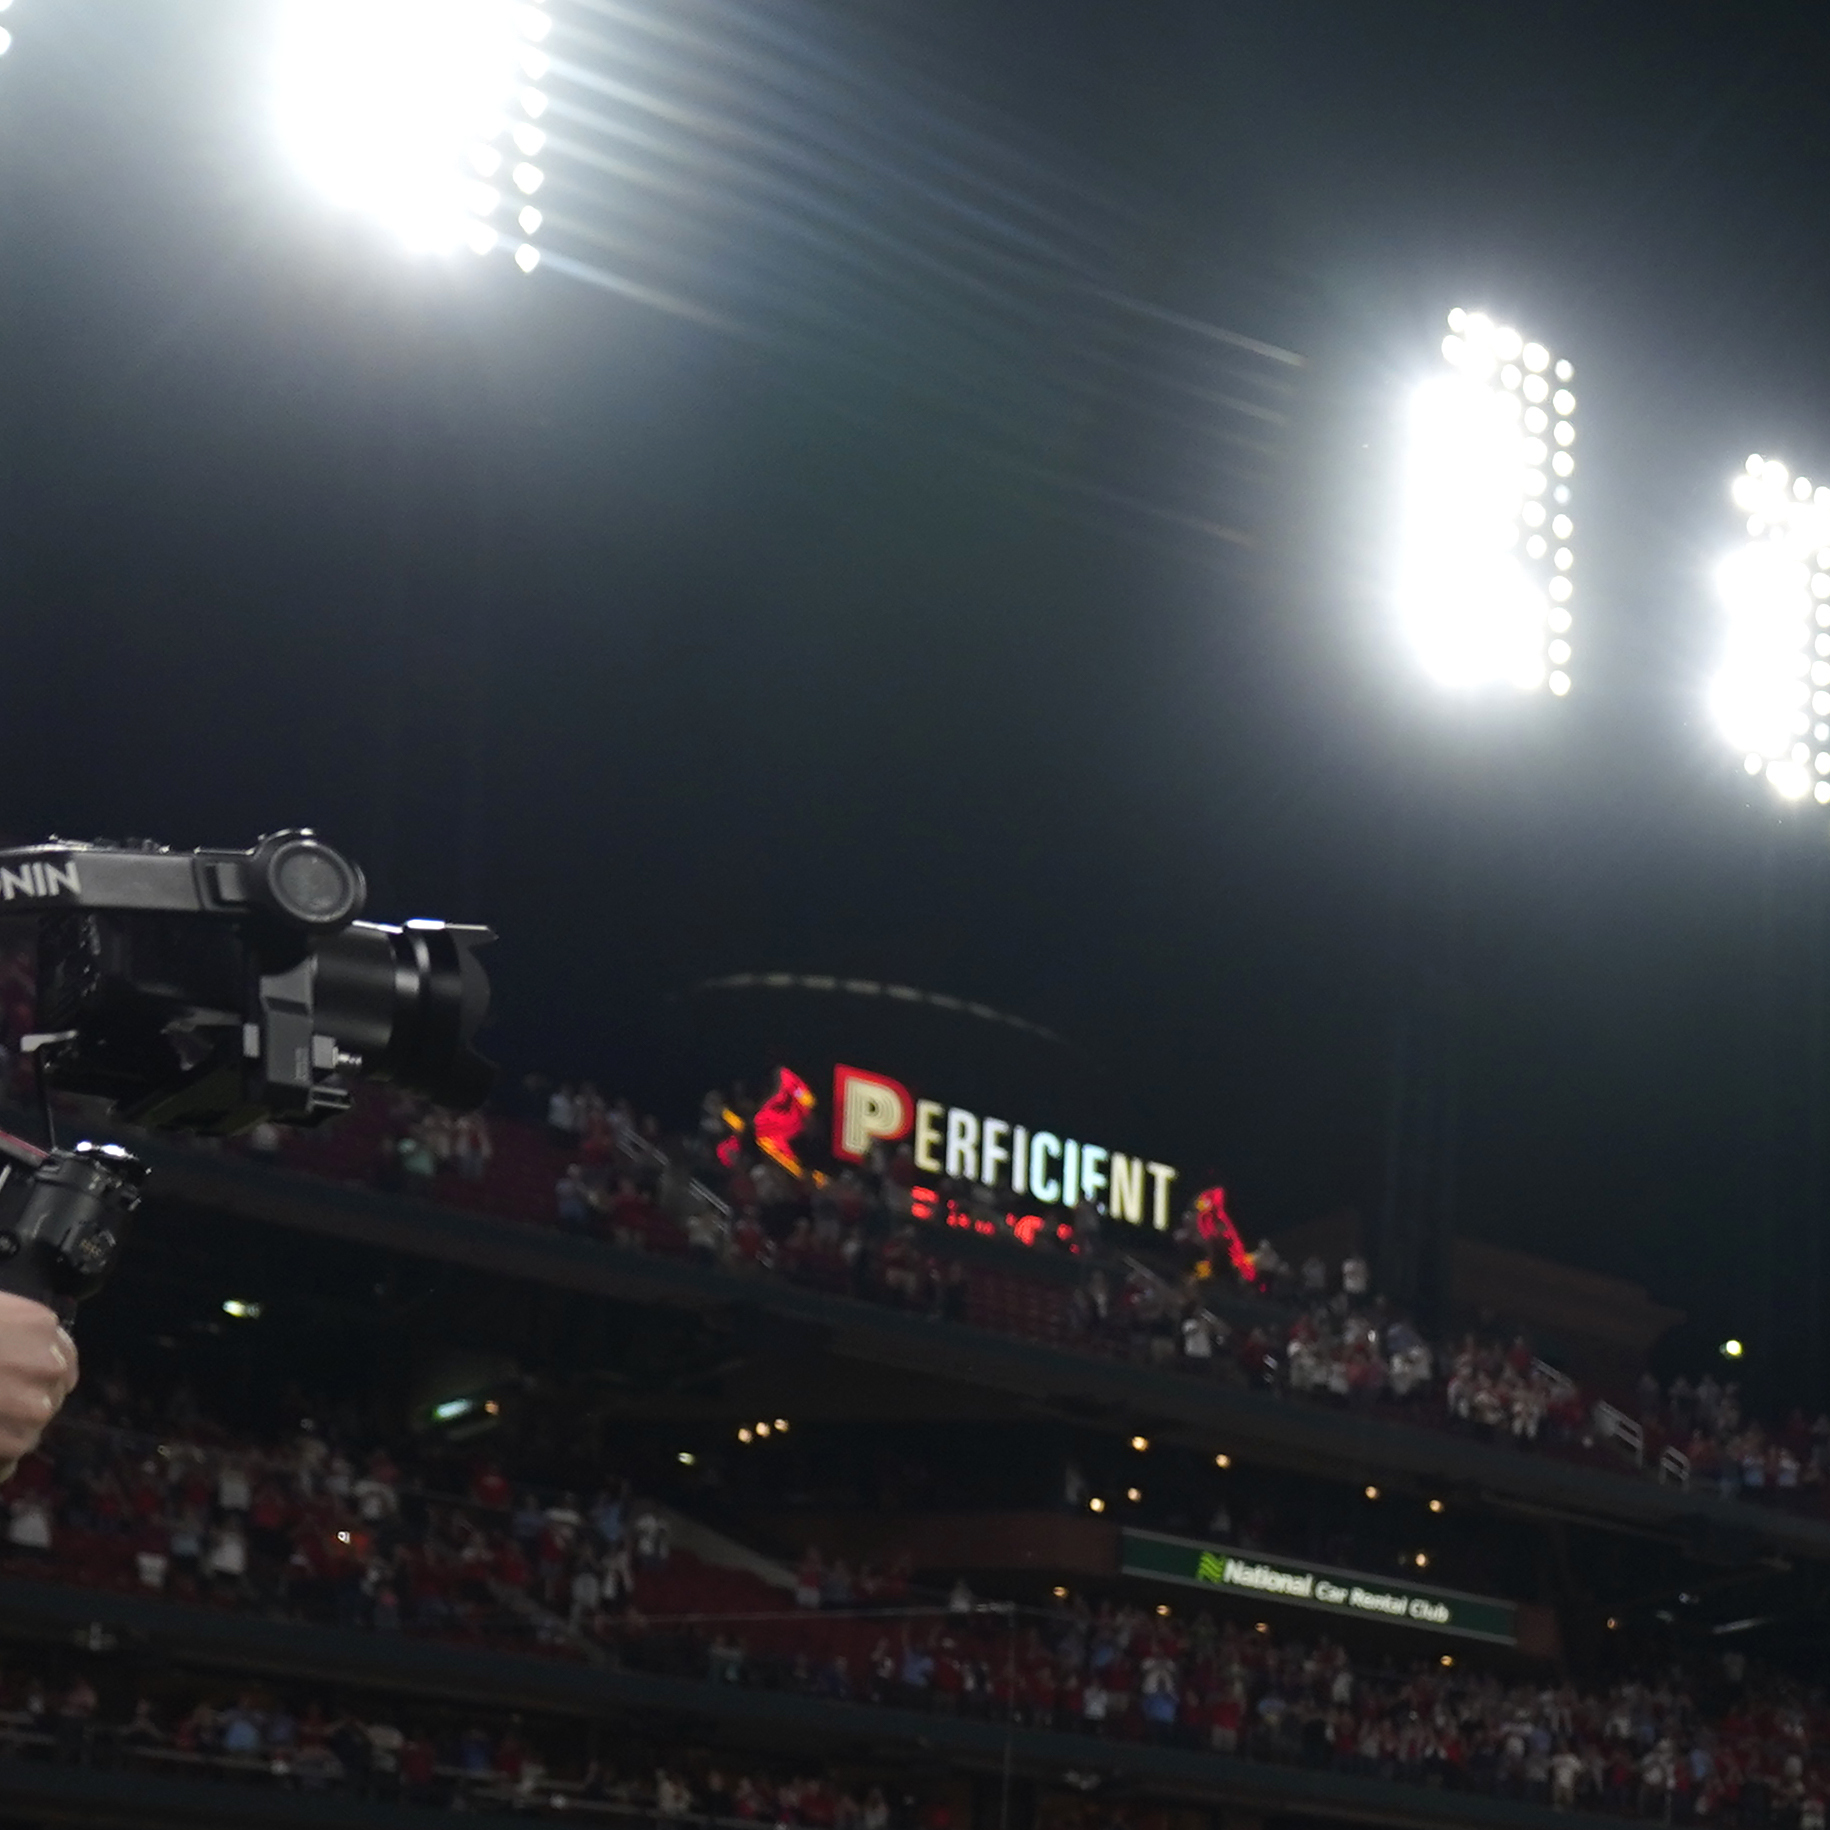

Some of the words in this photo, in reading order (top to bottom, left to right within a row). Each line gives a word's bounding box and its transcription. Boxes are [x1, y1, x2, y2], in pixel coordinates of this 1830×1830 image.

[0, 861, 82, 900] NIN
[832, 1063, 1178, 1231] PERFICIENT
[1224, 1558, 1314, 1598] National
[1315, 1580, 1349, 1605] Car
[1349, 1587, 1409, 1616] Rental
[1409, 1598, 1450, 1624] Club
